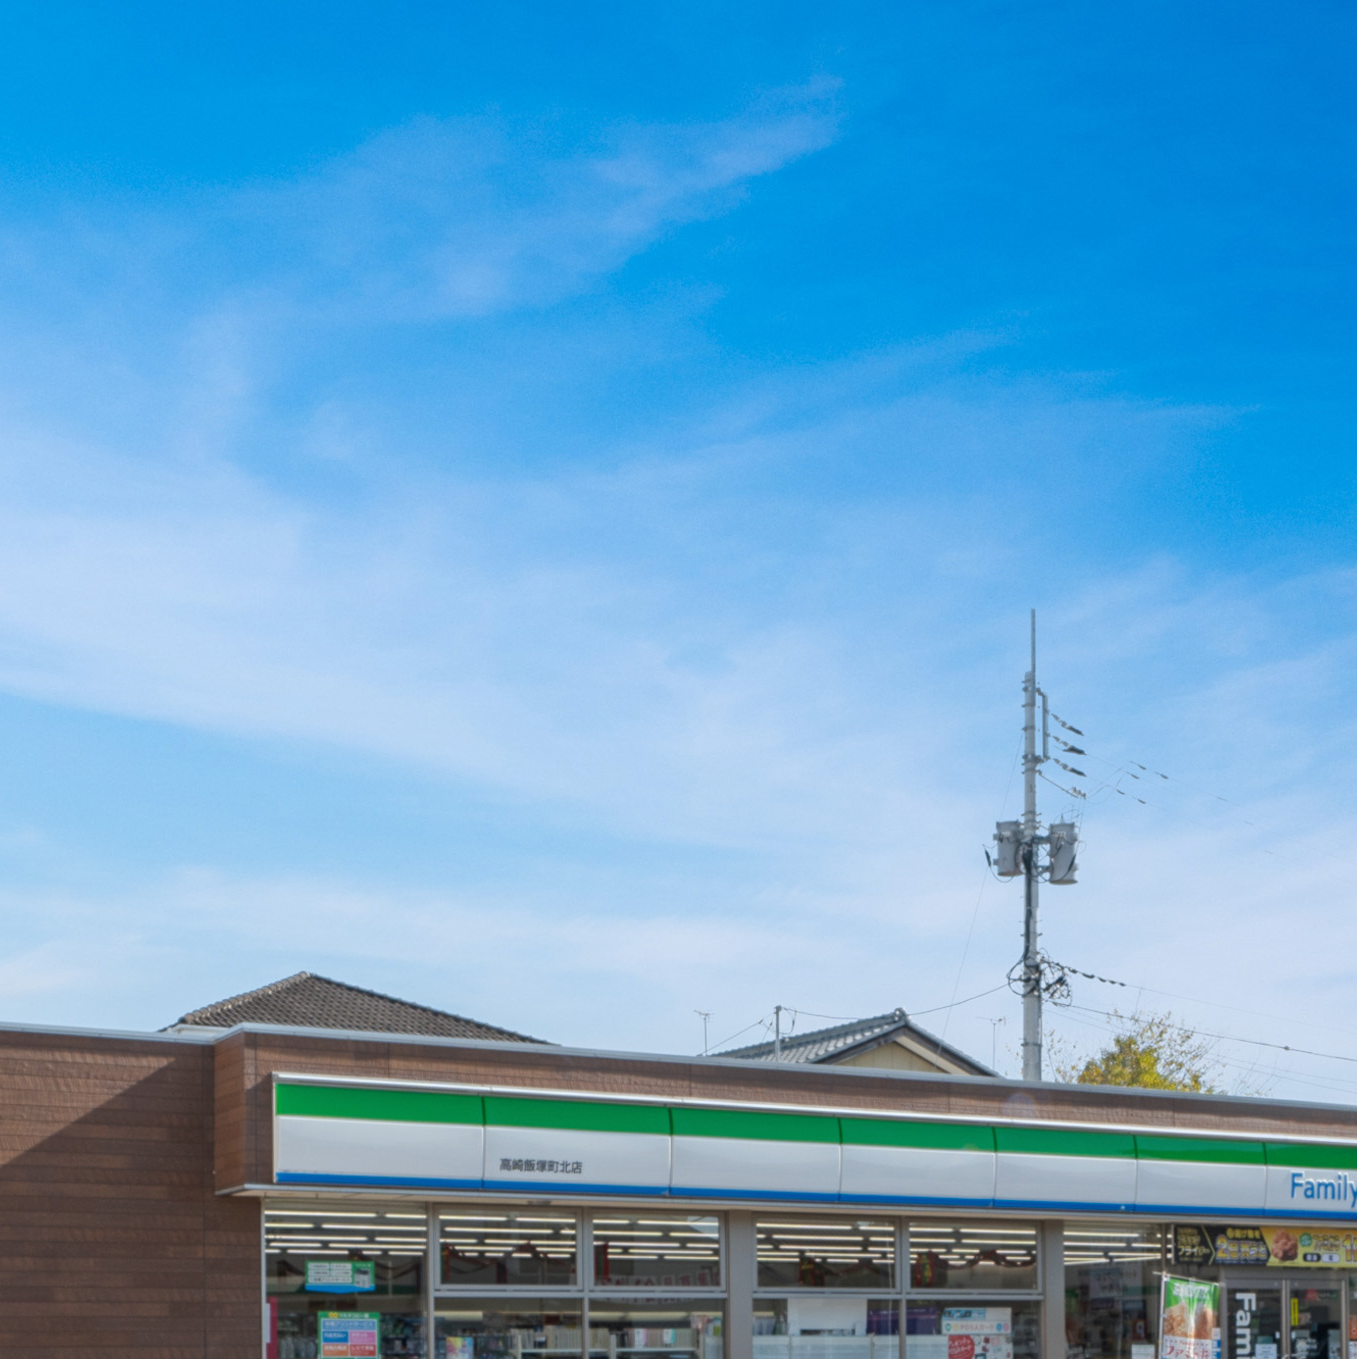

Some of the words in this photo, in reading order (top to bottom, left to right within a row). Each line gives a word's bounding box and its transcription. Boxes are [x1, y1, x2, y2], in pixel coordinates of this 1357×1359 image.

[500, 1158, 583, 1174] 高崎飯塚町北店
